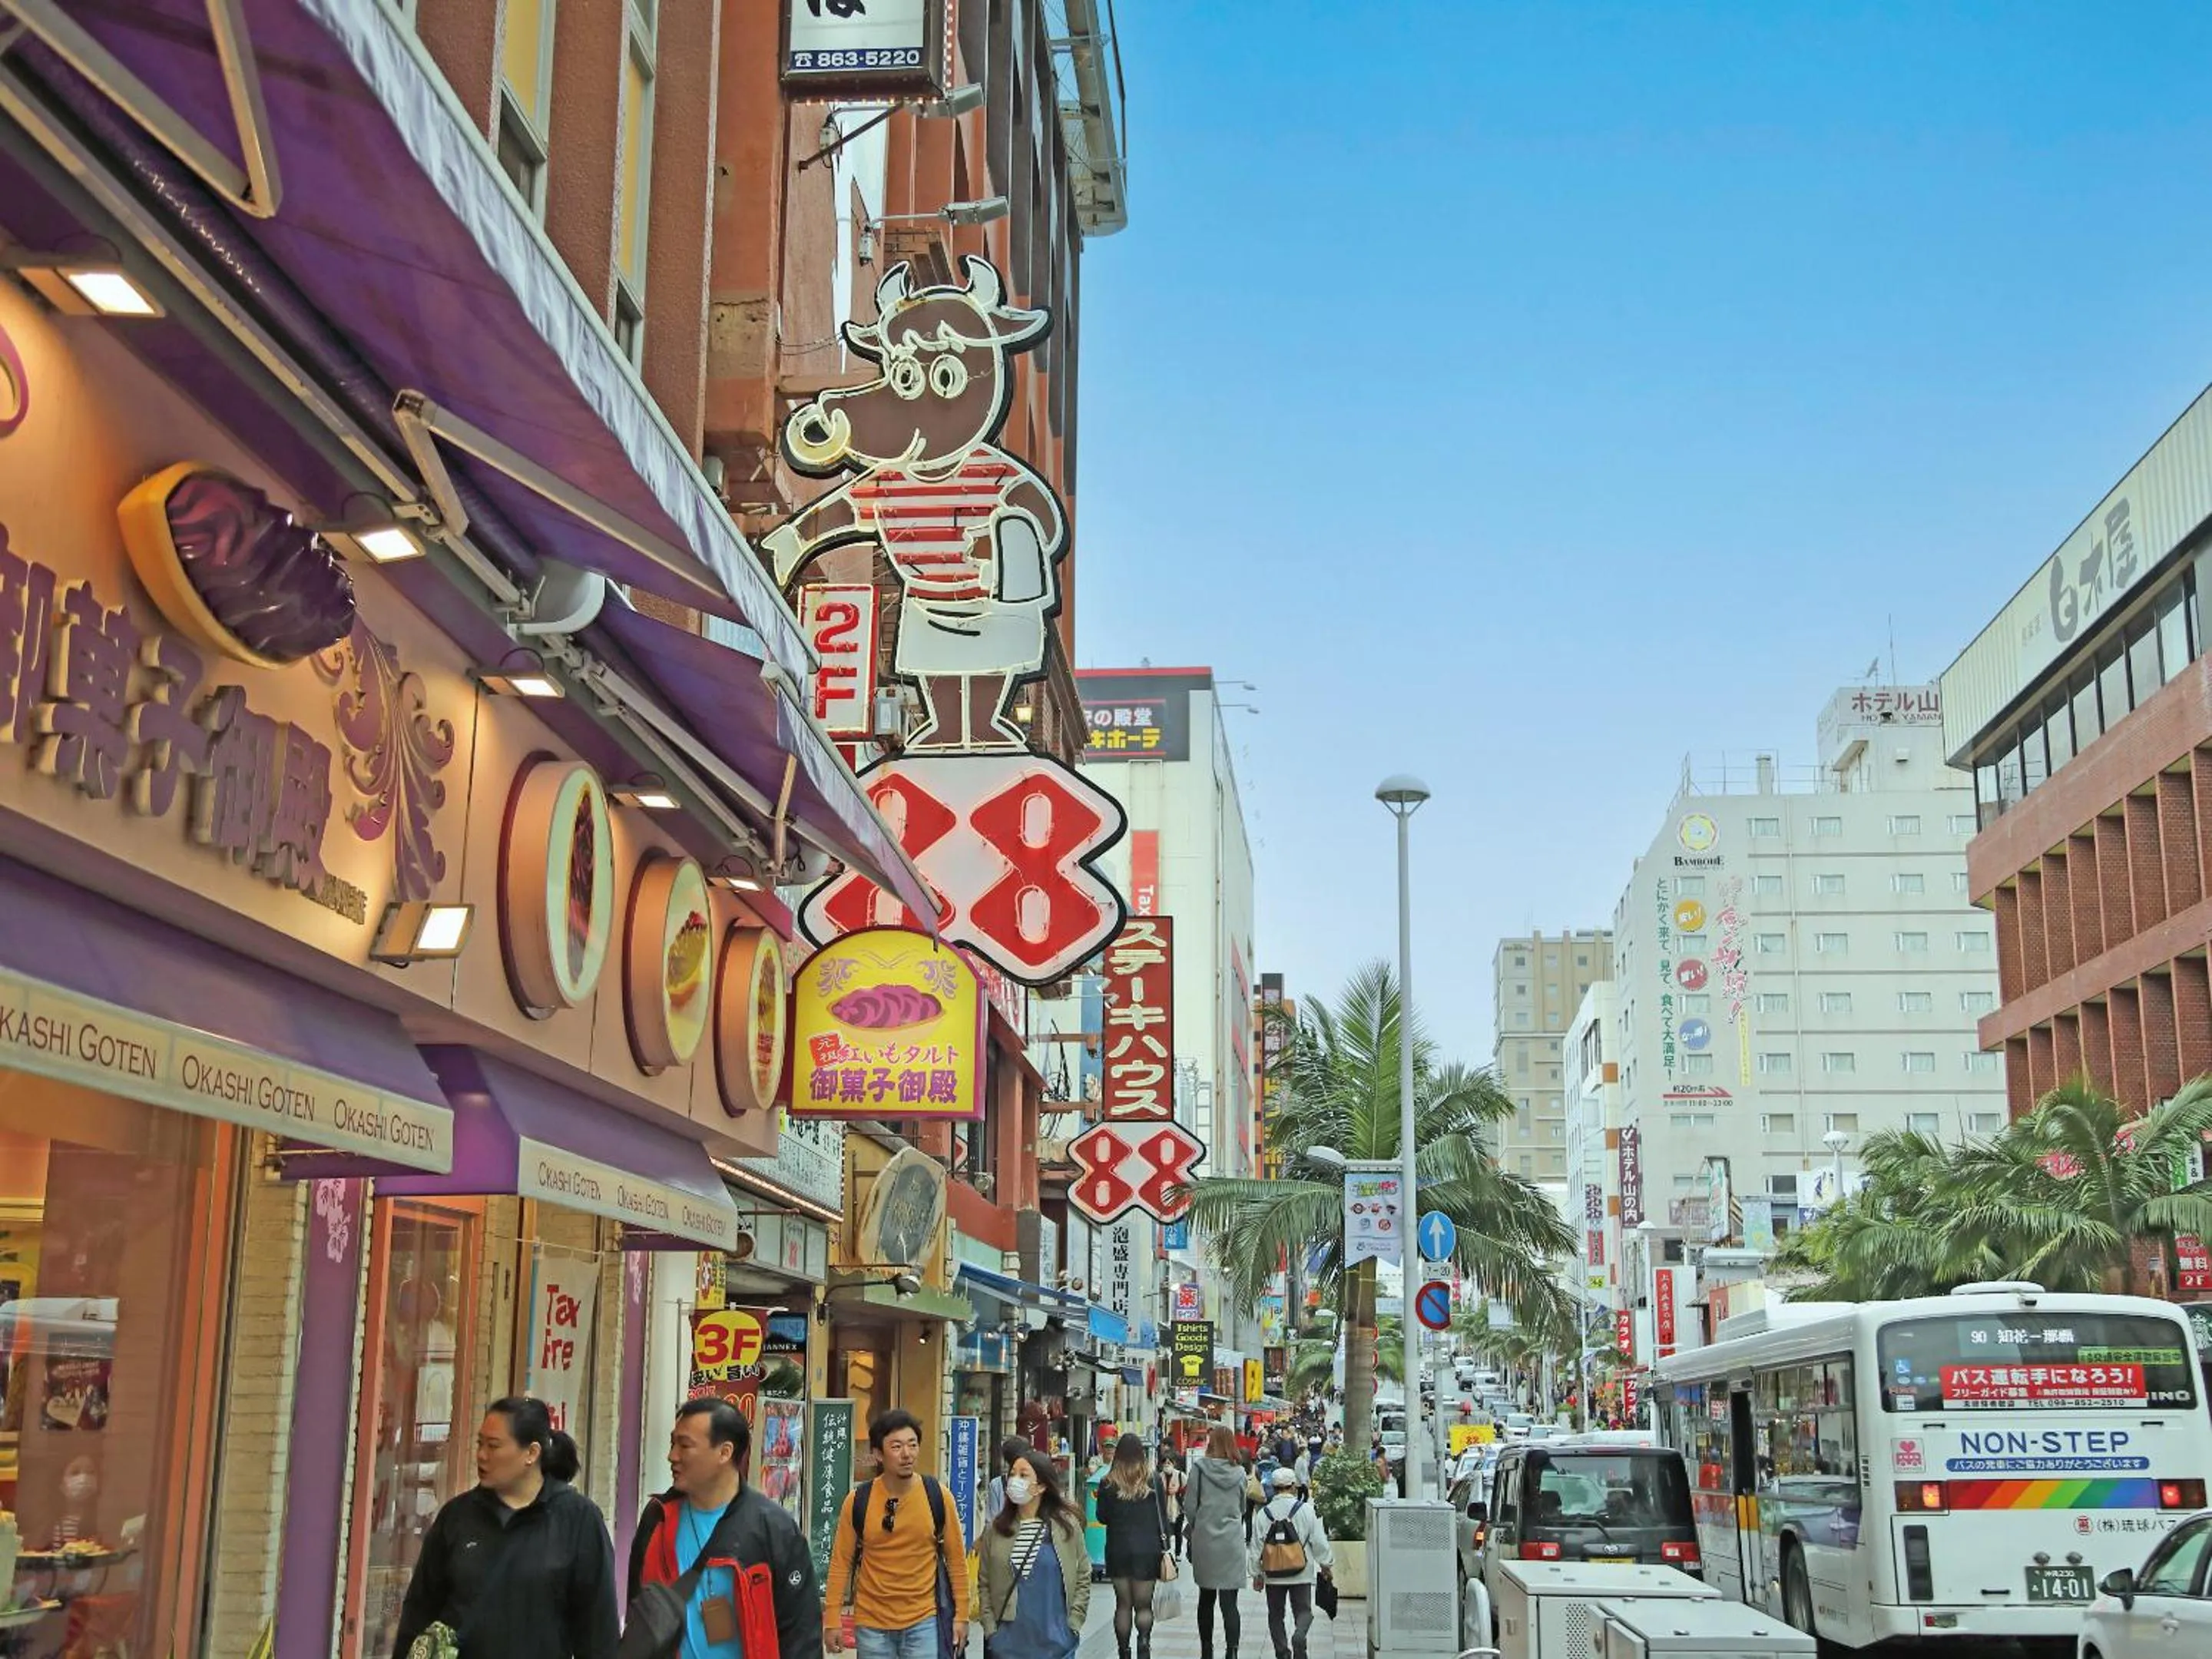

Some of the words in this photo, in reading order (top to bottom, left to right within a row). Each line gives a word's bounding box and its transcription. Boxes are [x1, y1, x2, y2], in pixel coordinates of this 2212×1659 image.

[814, 601, 861, 720] 2F
[1852, 690, 1940, 713] ホテル山
[1090, 727, 1163, 750] キホーテ
[1108, 921, 1168, 1116] ステーキハウス
[78, 1023, 157, 1080] GOTEN
[182, 1055, 253, 1106] OKASHI
[257, 1077, 316, 1122] GOTEN
[810, 1067, 959, 1104] 御菓子御殿
[333, 1098, 388, 1143] OKASHI
[390, 1114, 435, 1152] GOTEN
[1075, 1128, 1197, 1217] 88
[1621, 1145, 1638, 1222] ホテル山の内
[1112, 1226, 1130, 1316] 泡盛専門店
[697, 1323, 760, 1365] 3F
[1971, 1330, 1988, 1344] 90
[1950, 1367, 2133, 1385] バス運転手になろう!
[1960, 1431, 2130, 1455] NON-STEP
